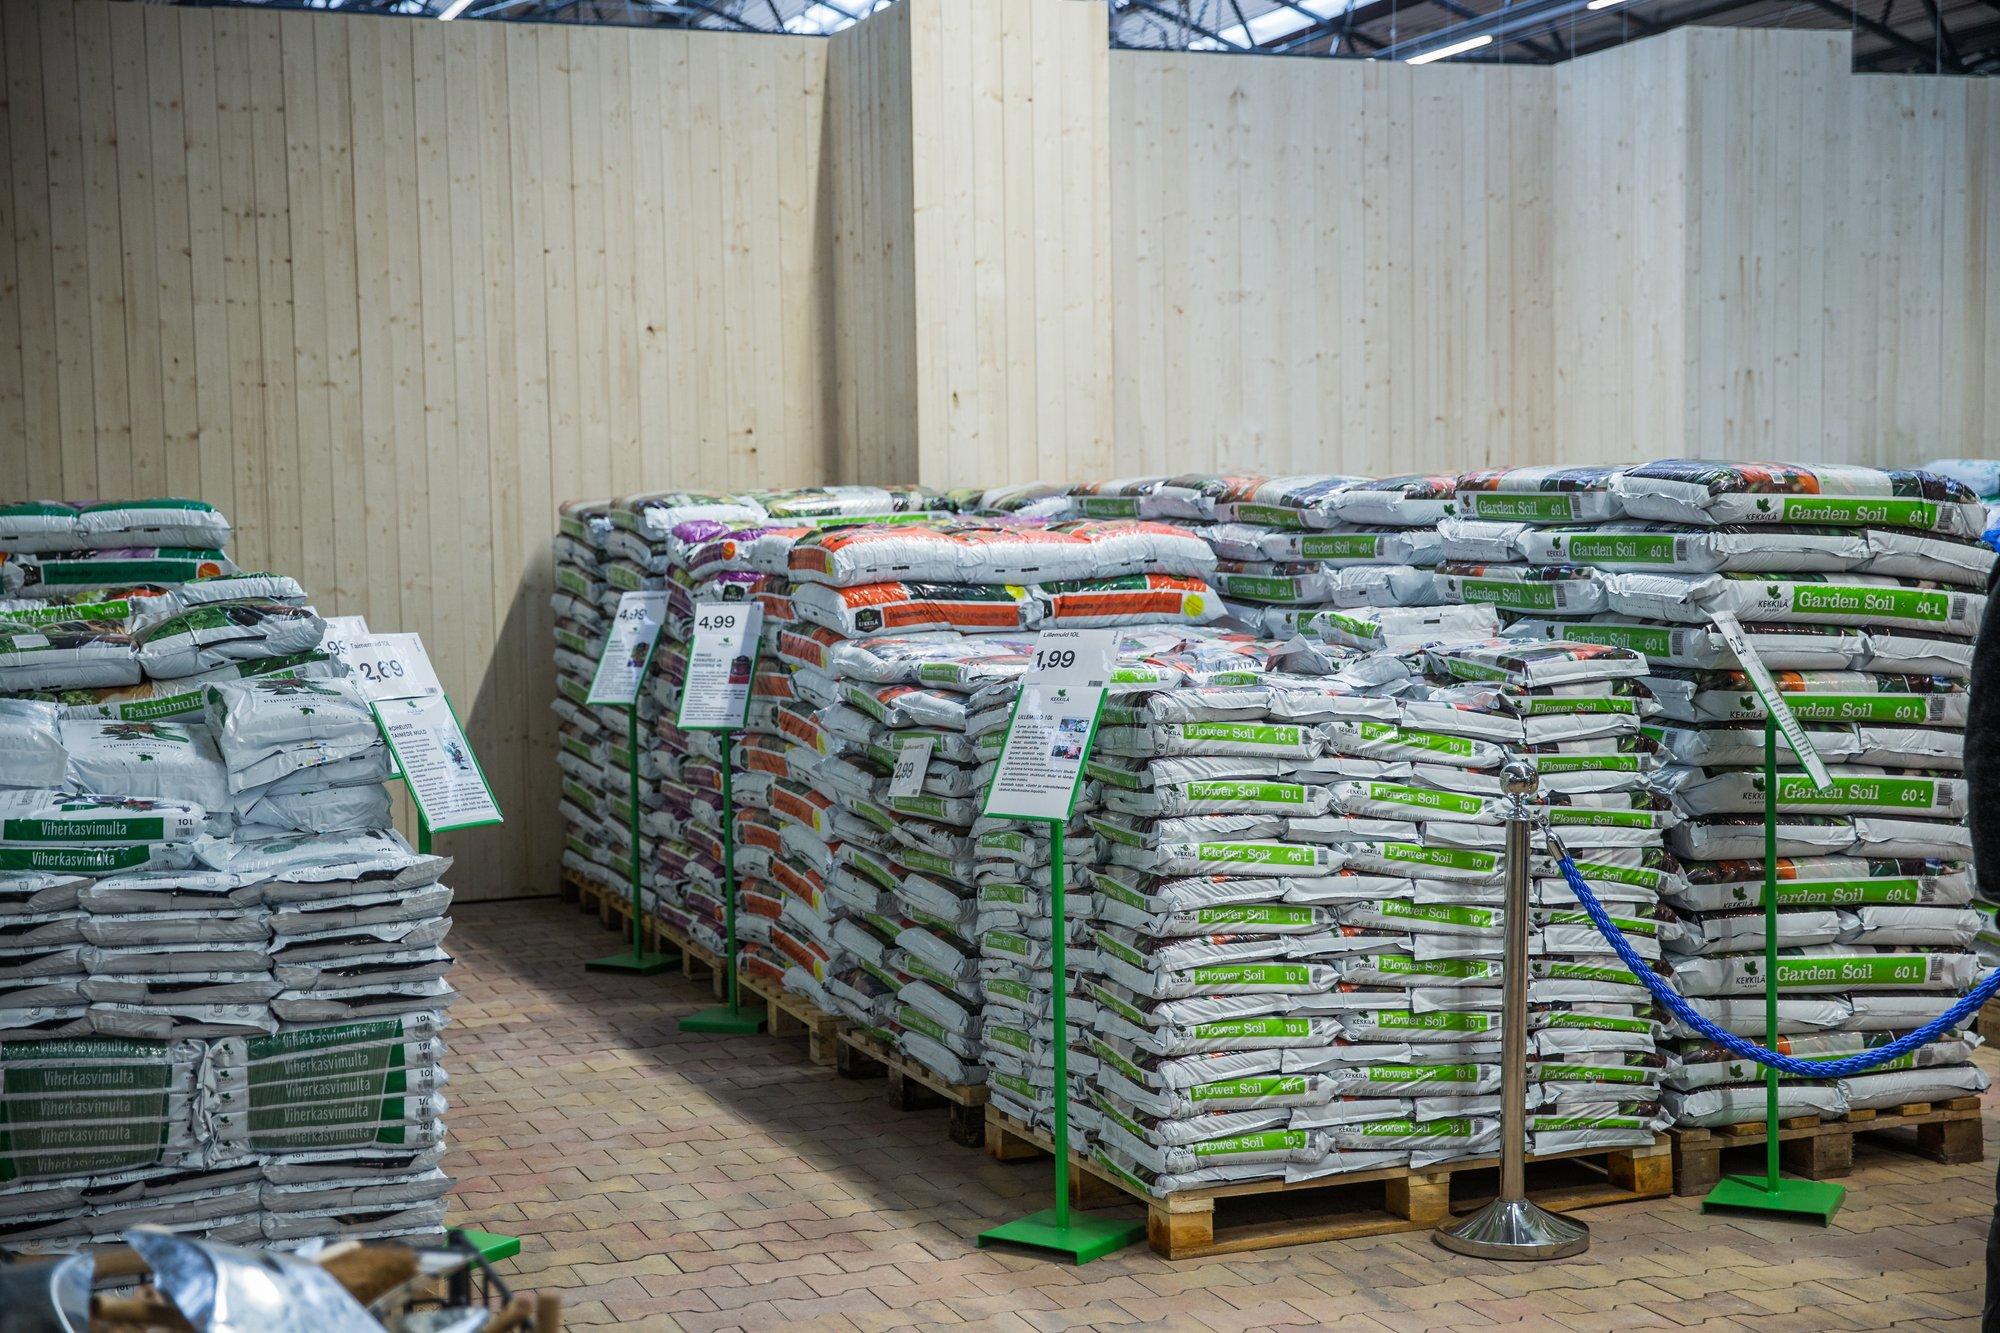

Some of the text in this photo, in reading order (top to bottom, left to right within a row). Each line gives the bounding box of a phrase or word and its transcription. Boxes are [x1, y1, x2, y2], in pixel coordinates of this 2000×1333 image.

[1479, 501, 1561, 515] Garden Soil 60
[1788, 503, 1922, 523] Garden Soil 60
[1746, 512, 1777, 522] KEKKILÄ
[1304, 543, 1334, 554] Garden
[1336, 542, 1350, 554] Soil
[1573, 542, 1662, 557] Garden Soil 60
[1231, 581, 1255, 594] Garden
[1257, 583, 1270, 595] Soil
[1465, 587, 1545, 604] Garden Soil 60
[1757, 598, 1789, 609] KEKKILÄ
[1799, 592, 1930, 614] Garden Soil 60
[698, 615, 735, 632] 4,99
[1566, 633, 1656, 650] Garden Soil 60
[1036, 650, 1075, 671] 1,99
[360, 660, 404, 682] 2,69
[124, 695, 204, 720] Taimimult
[1534, 703, 1574, 713] Flower
[1576, 701, 1597, 713] Soil
[1730, 709, 1762, 719] KEKKILÄ
[1786, 702, 1911, 719] arden Soil 60
[1187, 725, 1286, 741] Flower Soil 10
[1408, 732, 1461, 751] Soil 10
[895, 762, 914, 780] 2,99
[1541, 760, 1628, 771] Flower Soil 10
[1192, 784, 1233, 797] Flower
[1237, 786, 1260, 798] Soil
[1280, 791, 1291, 799] 10
[1374, 787, 1470, 810] Flower Soil 10
[1848, 785, 1917, 801] Soil 60
[1553, 813, 1641, 826] Flower Soil 10
[41, 821, 127, 835] Viherkasvimulta
[1202, 846, 1243, 859] Flower
[1247, 849, 1272, 860] Soil
[1388, 845, 1482, 868] Flower Soil 10
[1602, 870, 1623, 881] Soil
[1831, 888, 1902, 902] Soil 60
[1202, 909, 1299, 921] Flower Soil 10
[1386, 901, 1480, 923] Flower Soil 10
[1383, 959, 1476, 975] Flower Soil 10
[1777, 964, 1910, 983] Garden Soil 60
[1199, 969, 1296, 981] Flower Soil 10
[1381, 1014, 1476, 1028] Flower Soil 10
[1200, 1022, 1297, 1036] Flower Soil 10
[283, 1029, 367, 1047] Viherkasvimulta
[284, 1053, 369, 1074] Viherkasvimulta
[44, 1071, 134, 1086] Viherkasvimulta
[1373, 1067, 1412, 1078] Flower
[1456, 1068, 1466, 1078] 10
[1584, 1071, 1605, 1080] Soil
[286, 1078, 371, 1098] Viherkasvimulta
[1195, 1086, 1236, 1098] Flower
[1239, 1083, 1262, 1094] Soil
[40, 1099, 130, 1115] Viherkasvimulta
[284, 1103, 369, 1122] Viherkasvimulta
[40, 1126, 130, 1143] Viherkasvimulta
[1409, 1122, 1431, 1133] Soil
[286, 1129, 370, 1144] Viherkasvimulta
[1196, 1136, 1294, 1152] Flower Soil 10
[37, 1157, 126, 1172] Viherkasvimulta
